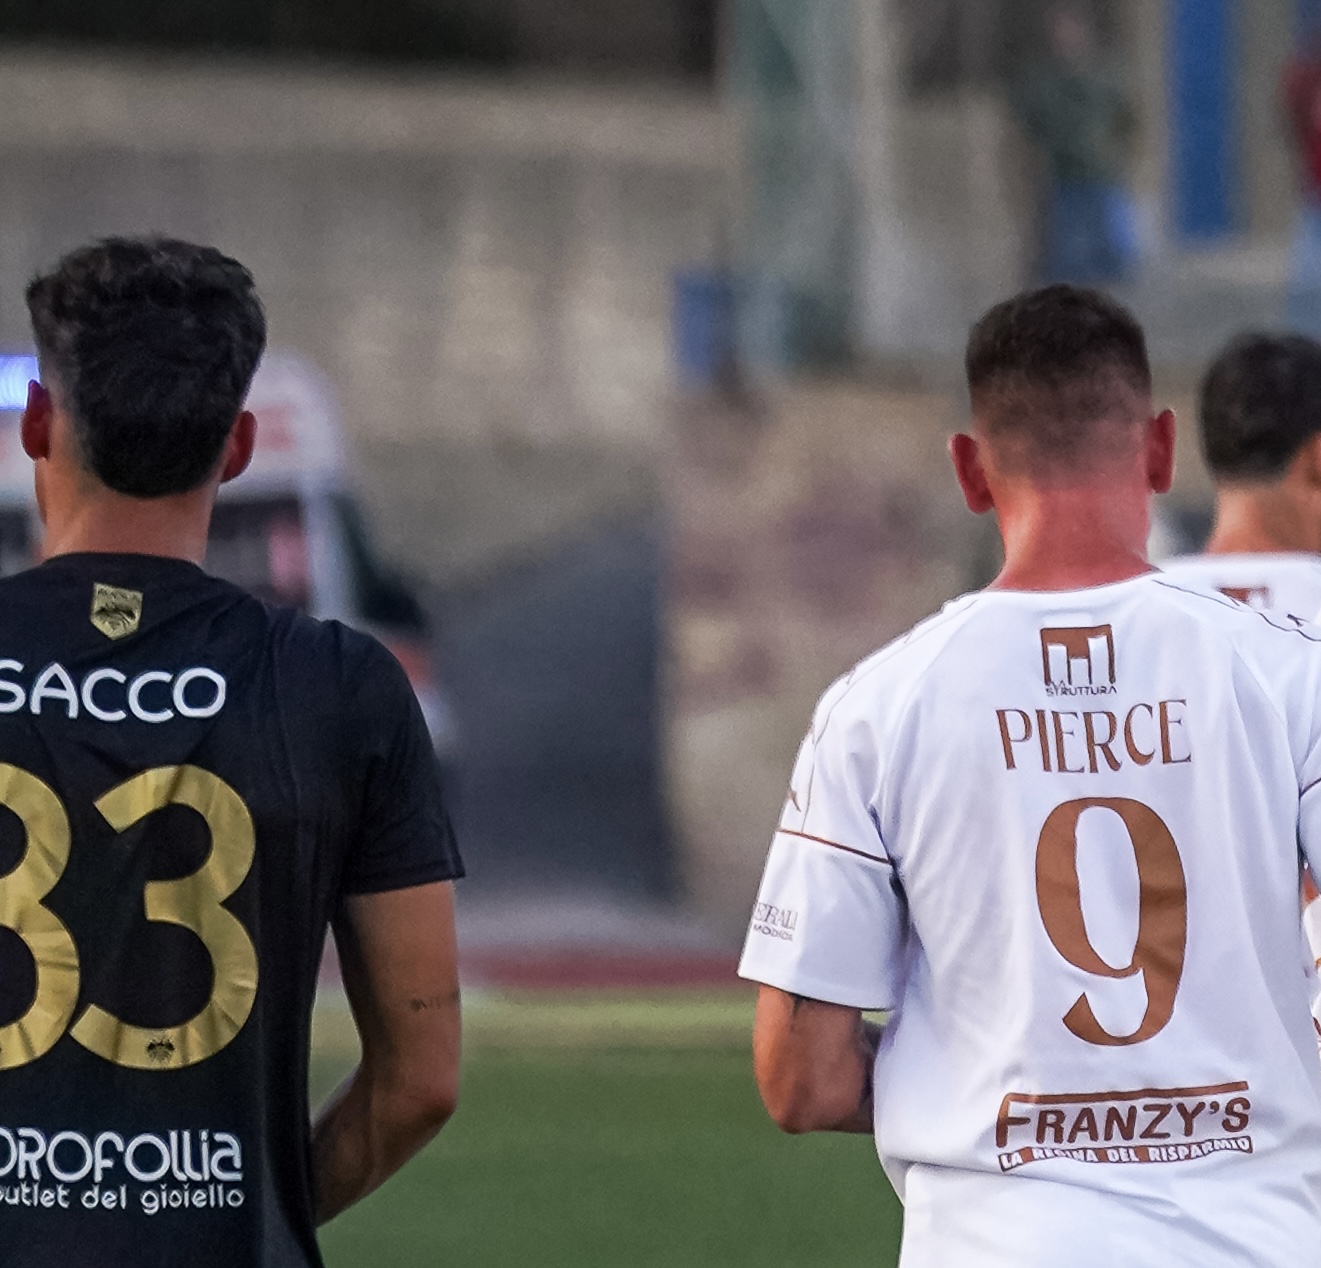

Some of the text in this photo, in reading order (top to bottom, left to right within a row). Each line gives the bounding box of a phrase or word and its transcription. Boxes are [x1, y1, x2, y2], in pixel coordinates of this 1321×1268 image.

[996, 699, 1191, 773] PIERCE
[1035, 797, 1187, 1046] 9
[996, 1081, 1251, 1148] FRANZY'S
[1000, 1152, 1024, 1169] LA
[1108, 1149, 1137, 1162] DEL
[1150, 1138, 1250, 1163] RISPARMIO
[0, 1181, 244, 1216] utlet del gioiello
